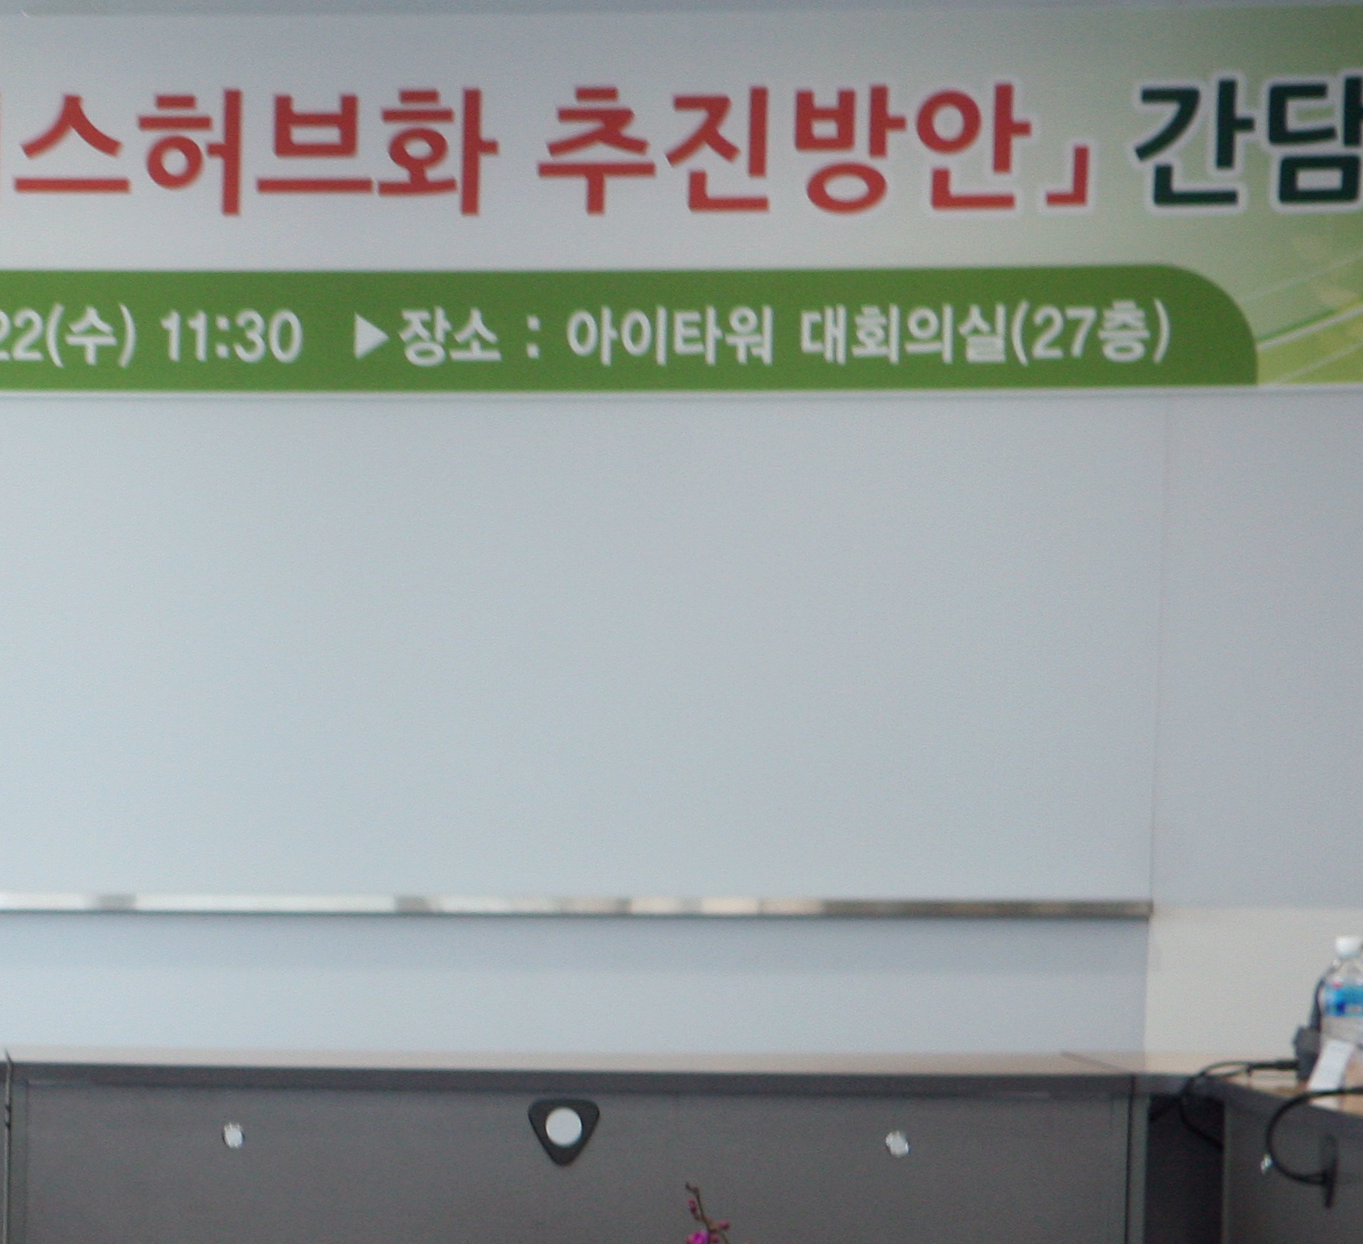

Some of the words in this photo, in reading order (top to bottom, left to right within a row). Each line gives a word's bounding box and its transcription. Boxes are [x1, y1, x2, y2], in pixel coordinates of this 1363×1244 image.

[1133, 76, 1363, 208] 간담
[160, 309, 304, 364] 11:30
[399, 306, 503, 367] 장소
[566, 306, 774, 366] 아이타워
[800, 300, 1171, 365] 대회의실(27층)
